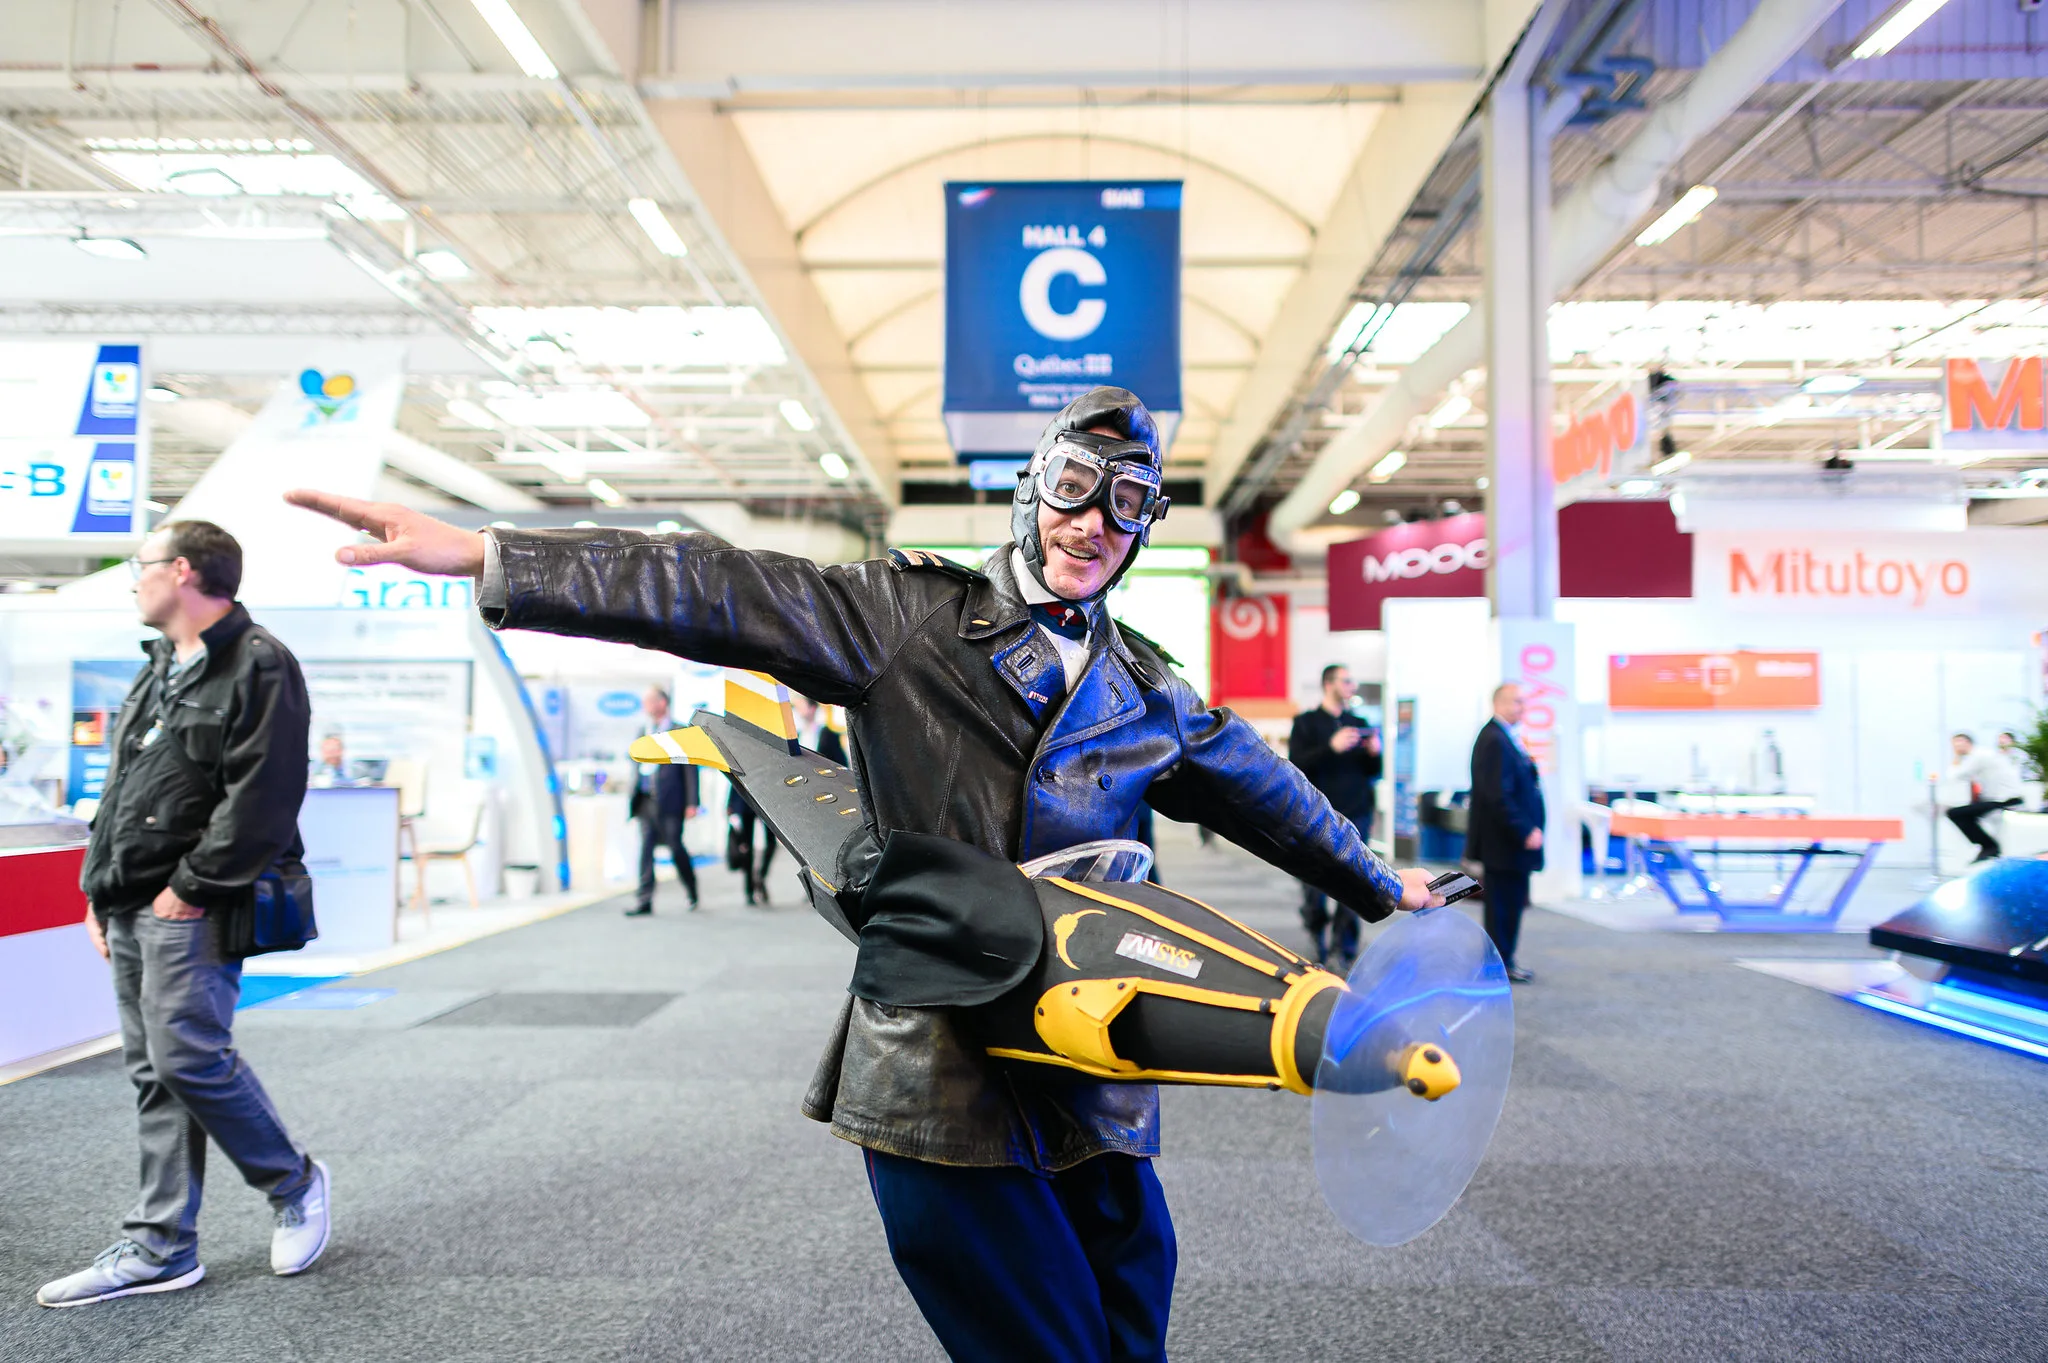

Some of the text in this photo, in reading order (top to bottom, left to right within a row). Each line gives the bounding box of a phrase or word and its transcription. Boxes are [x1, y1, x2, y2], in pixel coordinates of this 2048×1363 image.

[1022, 224, 1107, 249] HALL 4
[1019, 247, 1107, 341] C
[1729, 549, 1969, 609] Mitutoyo
[1127, 935, 1196, 969] ANSYS
